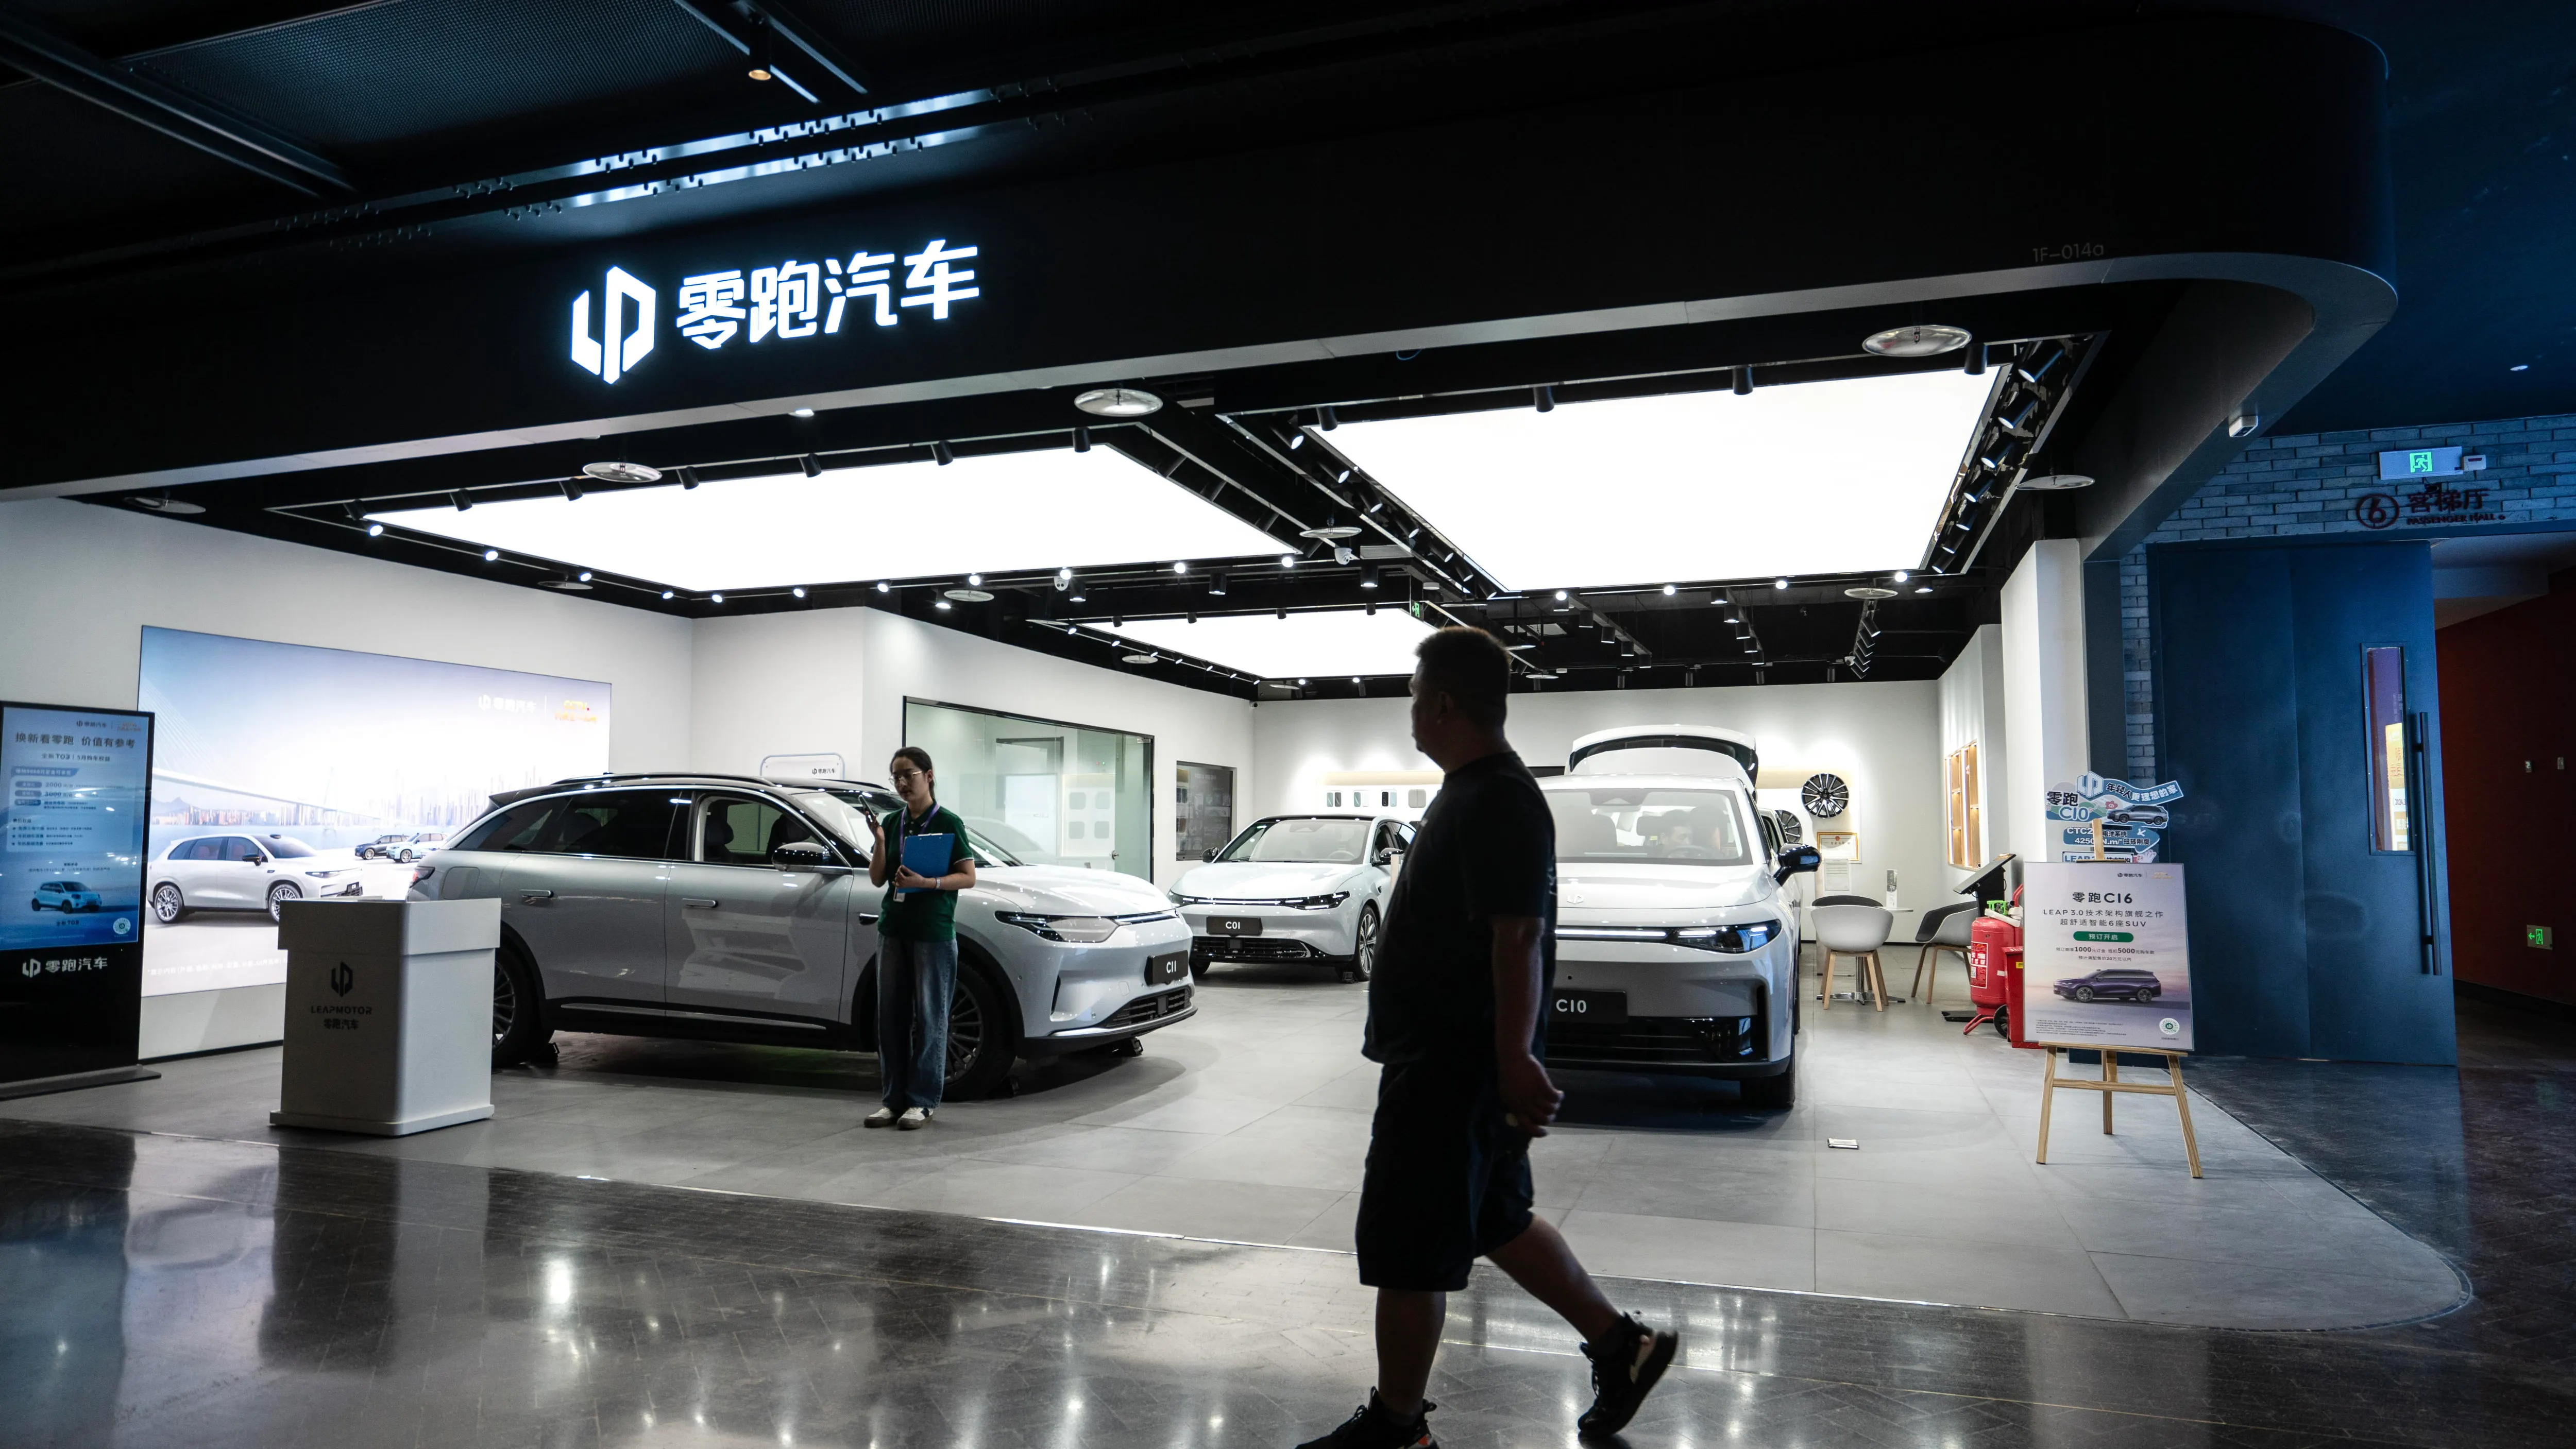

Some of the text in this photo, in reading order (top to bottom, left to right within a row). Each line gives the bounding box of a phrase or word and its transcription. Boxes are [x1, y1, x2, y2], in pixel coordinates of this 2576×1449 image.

[2032, 243, 2105, 263] 1F-014a
[676, 239, 979, 350] 零跑汽车
[2408, 489, 2490, 513] 客梯厅
[15, 731, 135, 748] 换新看零跑 价值有参考
[2046, 791, 2078, 807] 零跑
[2106, 783, 2179, 802] 年轻人更理想的家
[2059, 806, 2090, 821] C10
[2072, 892, 2133, 904] 零跑C16
[1225, 921, 1241, 930] C01
[2060, 918, 2146, 927] 超舒适智能6座SUV
[45, 957, 108, 974] 零跑汽车
[1166, 960, 1177, 974] C11
[311, 1005, 373, 1015] LEAPMOTOR
[1556, 998, 1587, 1013] C10
